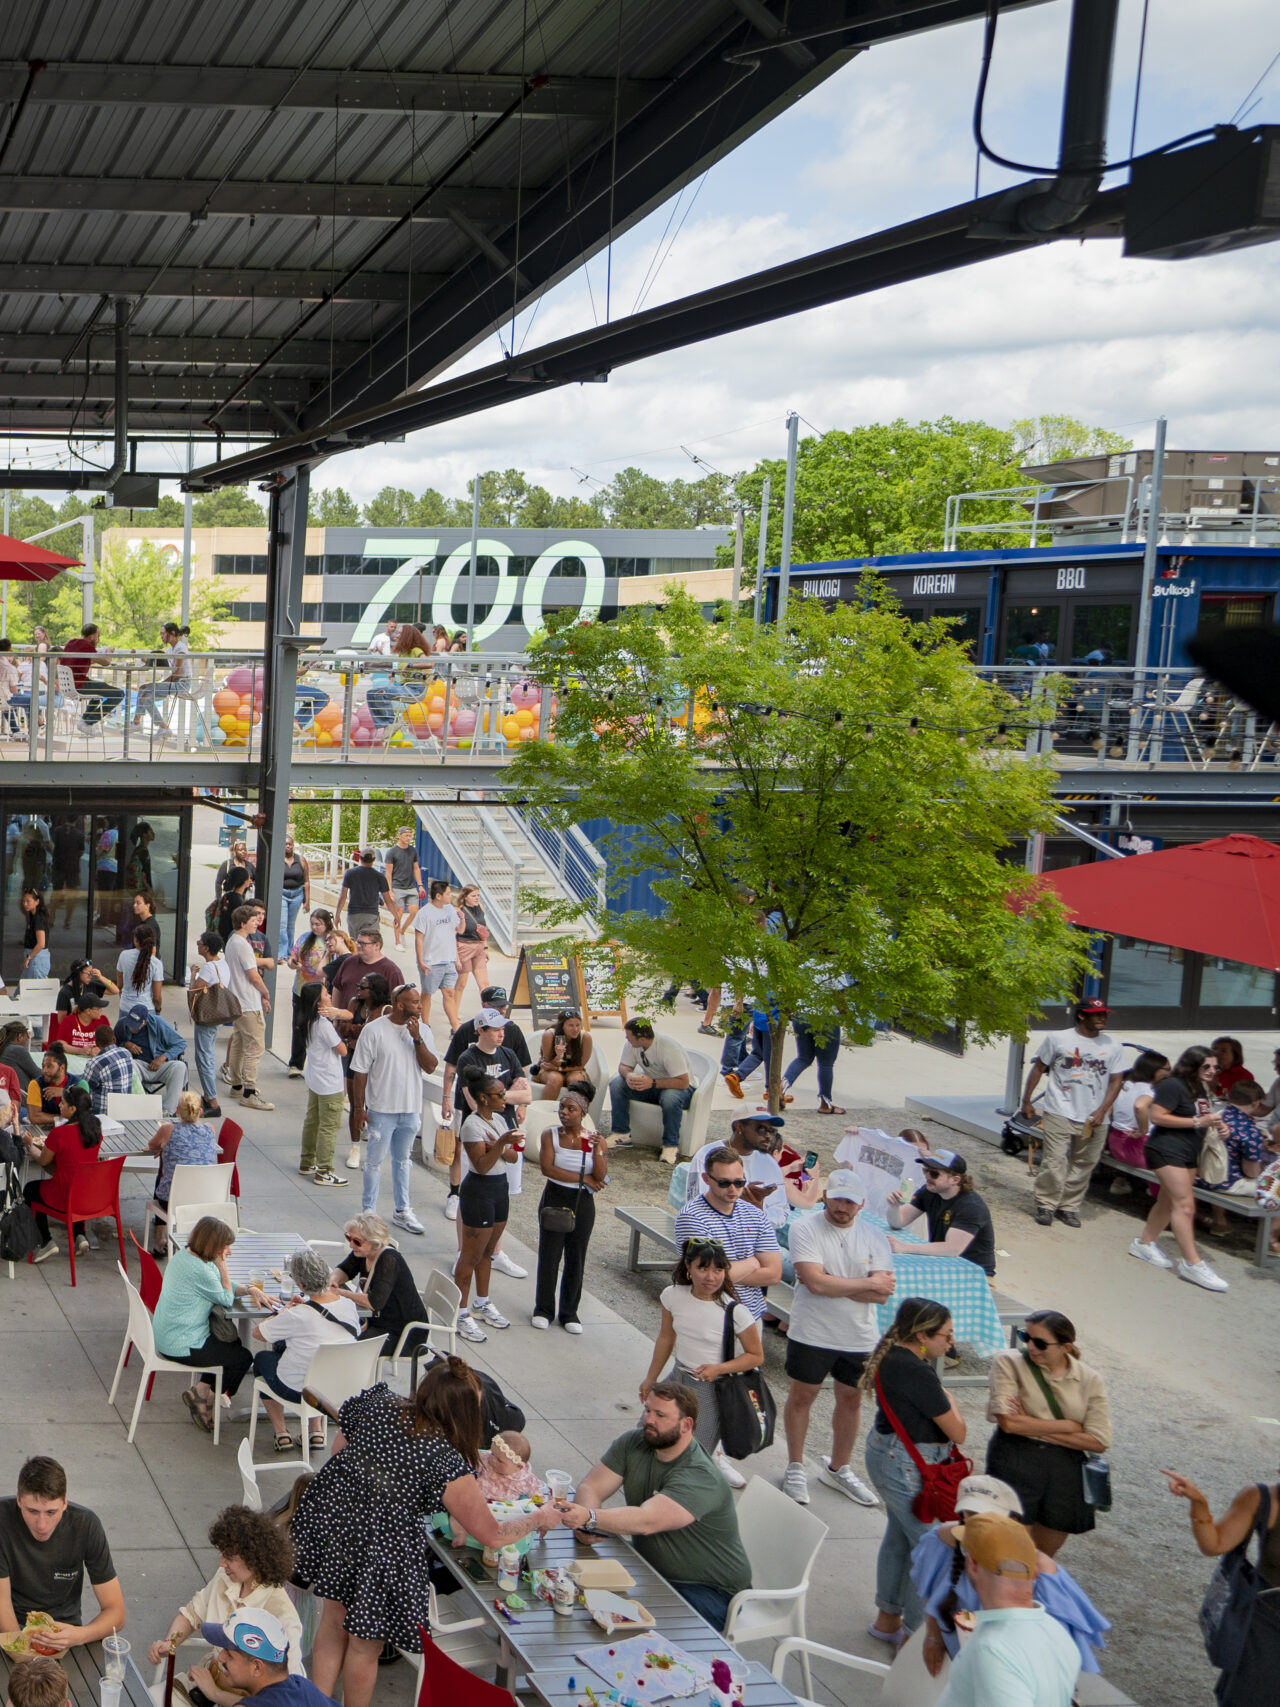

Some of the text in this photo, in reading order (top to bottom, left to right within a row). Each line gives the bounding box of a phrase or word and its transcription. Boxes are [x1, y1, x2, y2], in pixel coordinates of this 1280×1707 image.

[803, 579, 841, 598] BULKOGI
[913, 573, 956, 595] KOREAN
[1056, 567, 1086, 590] BBQ
[1152, 580, 1196, 597] Bulkogi
[351, 539, 606, 645] 700
